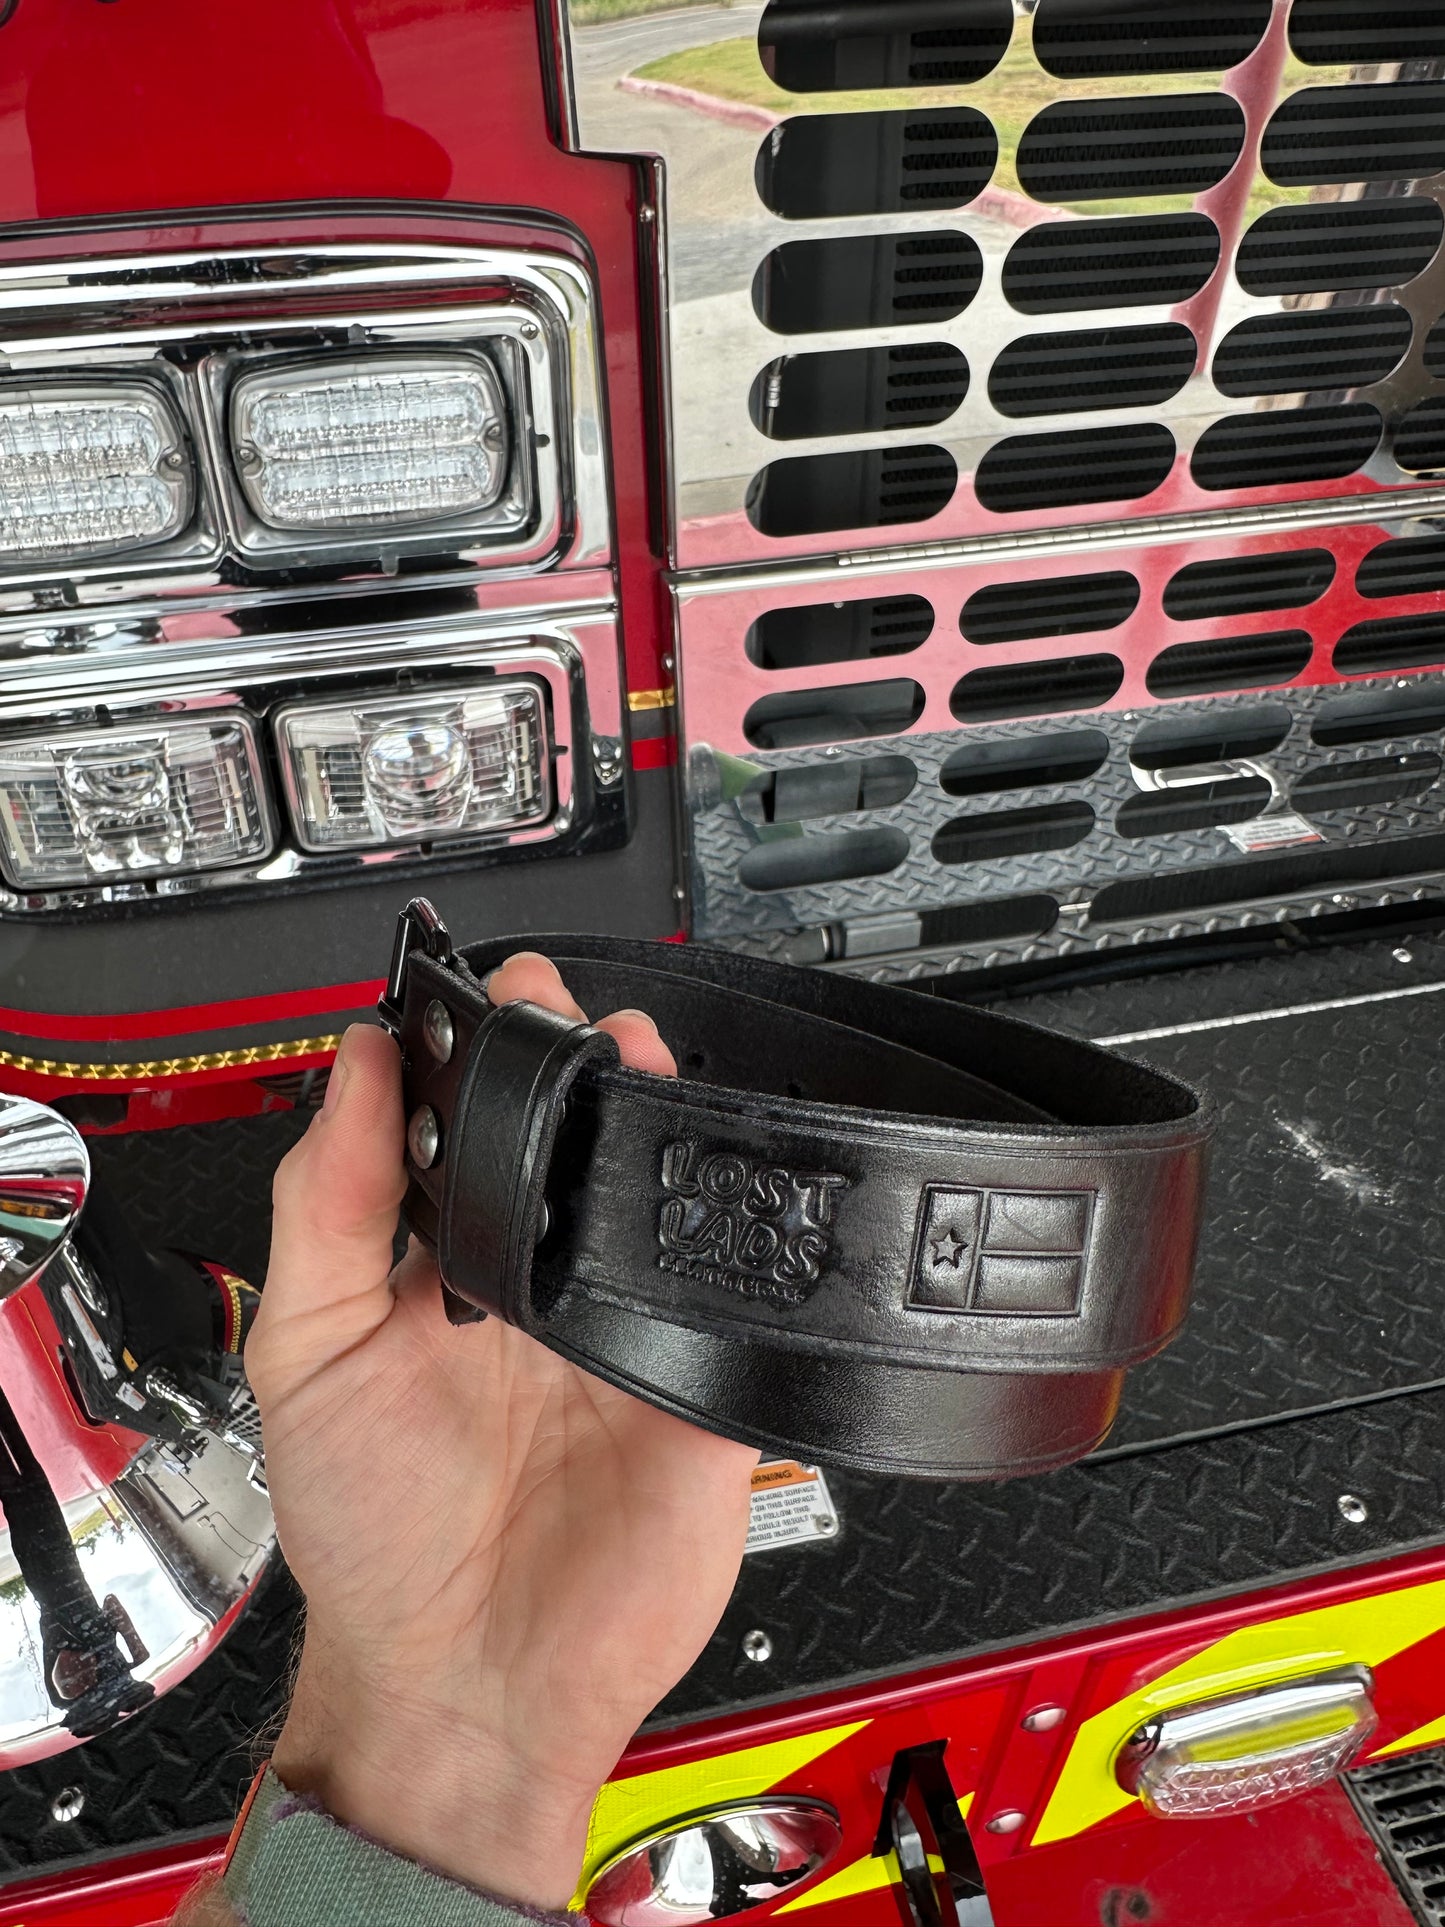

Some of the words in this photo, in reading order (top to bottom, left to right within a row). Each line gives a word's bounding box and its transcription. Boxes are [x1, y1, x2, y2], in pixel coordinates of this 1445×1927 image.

[662, 1142, 849, 1226] LOST
[659, 1199, 828, 1285] LADS
[751, 1469, 793, 1485] RNING
